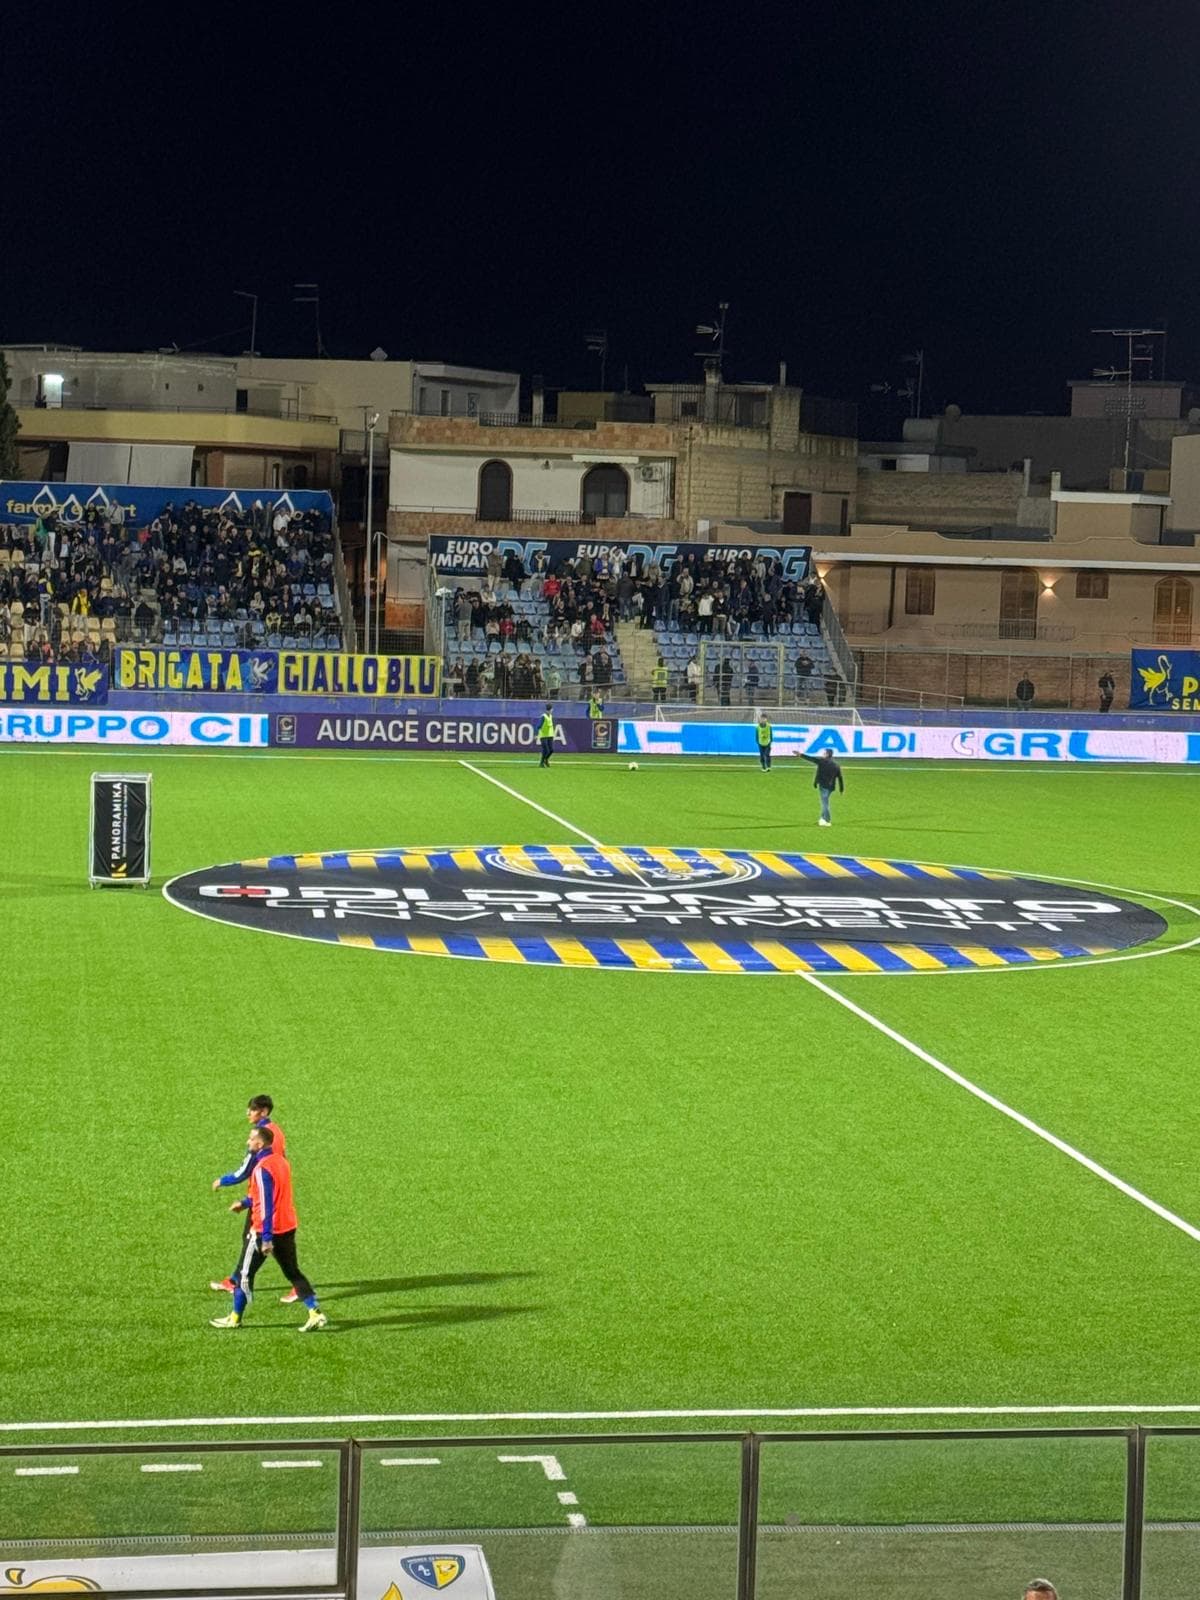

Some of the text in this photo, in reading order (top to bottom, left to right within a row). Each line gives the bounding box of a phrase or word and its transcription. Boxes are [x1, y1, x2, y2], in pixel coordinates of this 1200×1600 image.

[447, 540, 493, 555] EURO
[432, 553, 507, 569] IMPIANI
[120, 650, 243, 690] BRIGATA
[0, 714, 170, 740] RUPPO
[316, 718, 567, 746] AUDACE CERIGNOA
[111, 782, 122, 860] PANORAMIKA
[265, 899, 983, 920] COSTRUZIONI
[311, 908, 1063, 932] INVESTIMENTI
